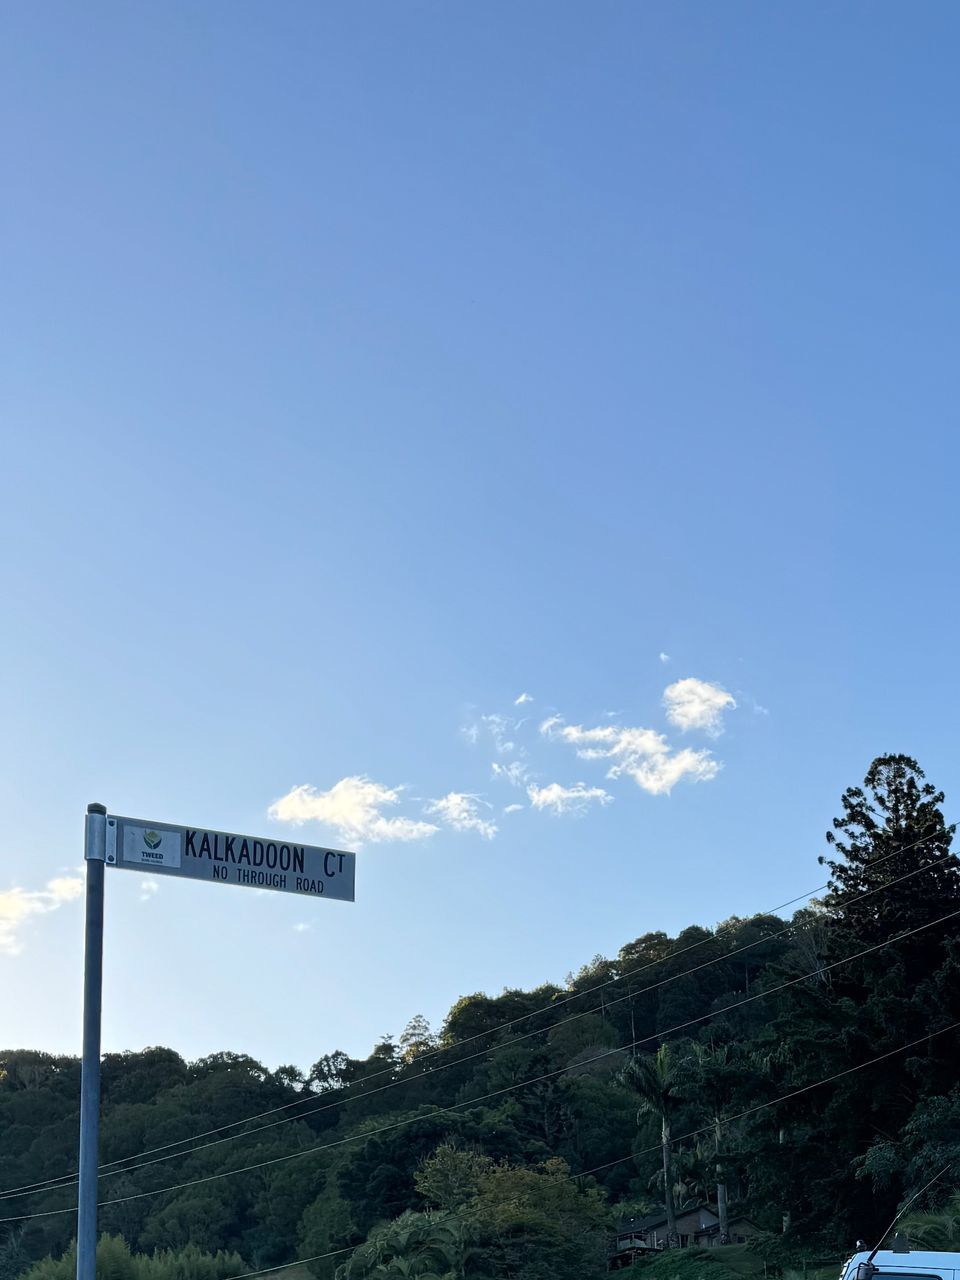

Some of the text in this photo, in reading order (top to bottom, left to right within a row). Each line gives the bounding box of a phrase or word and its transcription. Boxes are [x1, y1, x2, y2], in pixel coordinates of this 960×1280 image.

[141, 851, 164, 860] TWEED
[185, 829, 305, 873] KALKADOON
[213, 865, 324, 894] NO THROUGH ROAD
